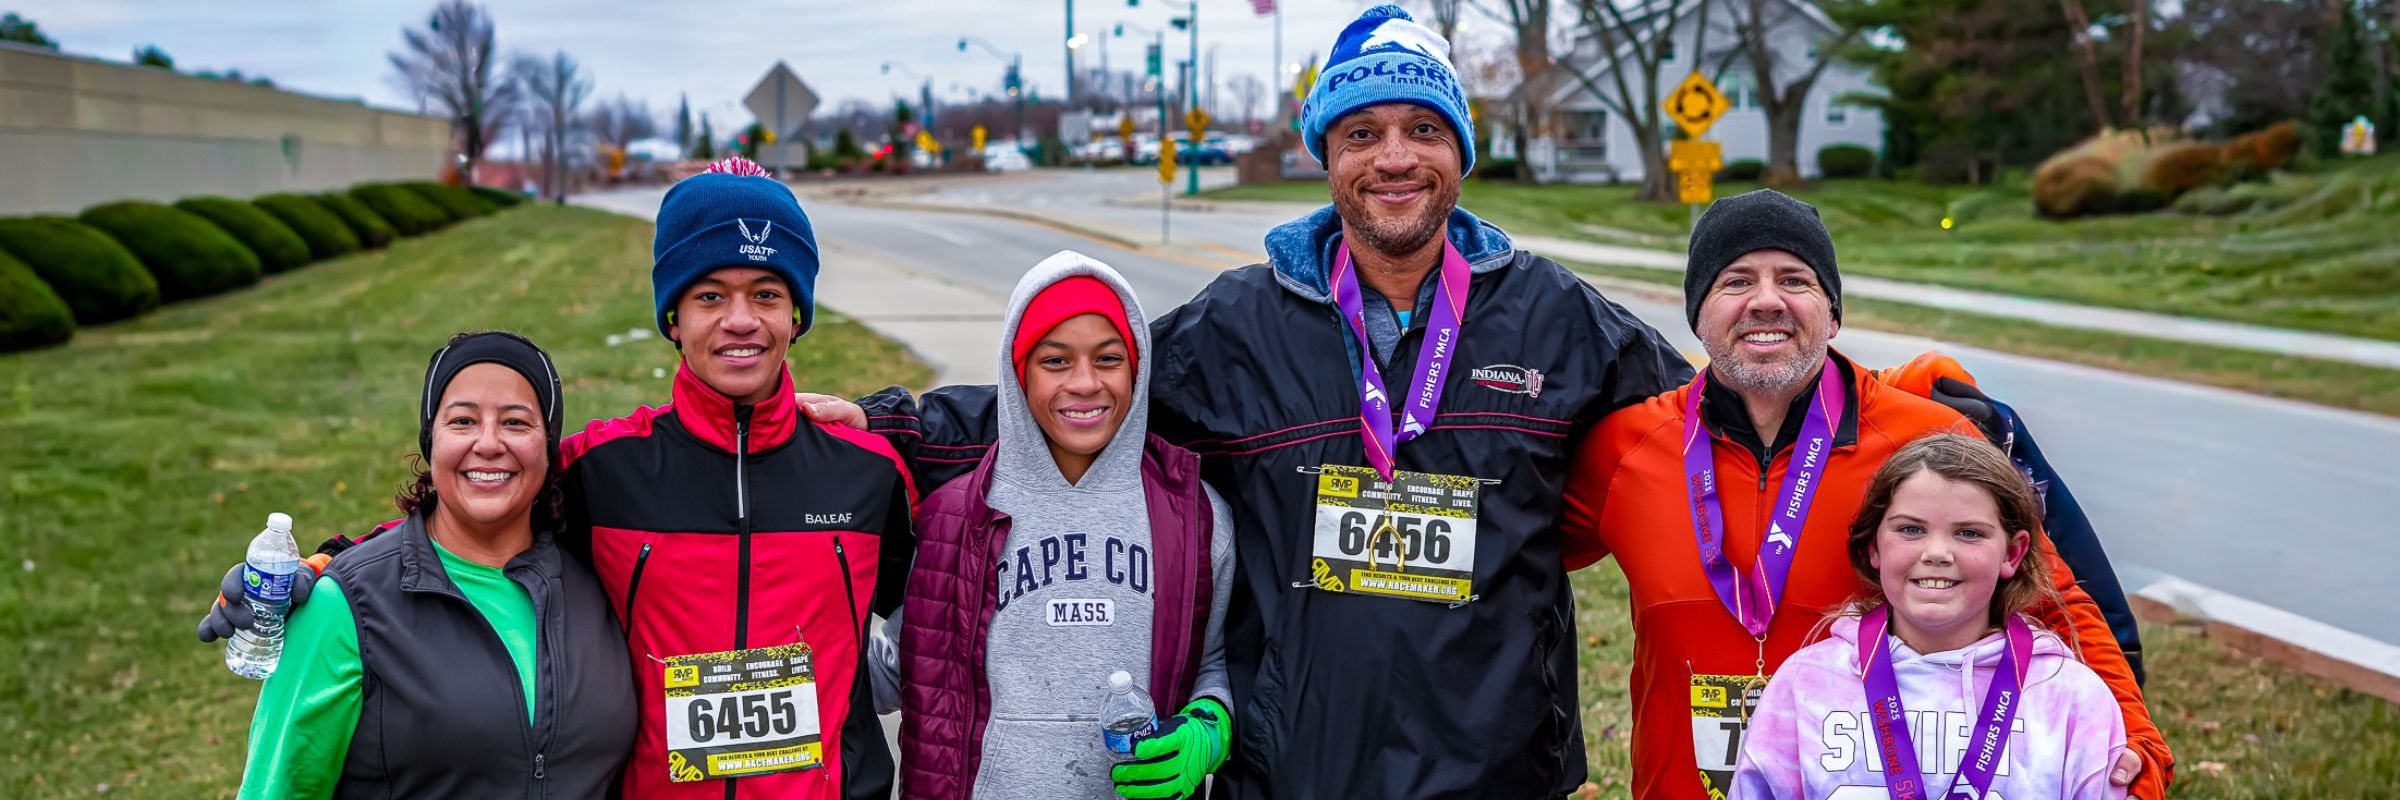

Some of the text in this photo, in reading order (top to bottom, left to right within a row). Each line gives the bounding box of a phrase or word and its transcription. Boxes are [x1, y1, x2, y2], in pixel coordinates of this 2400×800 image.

[1328, 60, 1449, 93] POLAR
[739, 244, 778, 256] USATF
[1419, 361, 1441, 409] FISHERS
[1432, 327, 1452, 365] YMCA
[1703, 468, 1712, 492] 2025
[1407, 485, 1445, 496] ENCOURAGE
[1452, 489, 1474, 498] SHAPE
[1775, 544, 1784, 555] the
[1786, 470, 1811, 519] FISHERS
[1803, 437, 1824, 469] YMCA
[1411, 495, 1439, 505] FITNESS.
[1452, 499, 1473, 508] LIVES.
[1690, 471, 1714, 545] WISHBONE
[805, 512, 853, 524] BALEAF
[1338, 511, 1452, 565] 6456
[996, 532, 1155, 613] CAPE CO
[1360, 578, 1458, 595] WWW.RACEMAKER.ORG
[1053, 603, 1109, 623] MASS.
[712, 664, 732, 674] BUILD
[745, 659, 784, 671] ENCOURAGE
[790, 655, 809, 665] SHAPE
[791, 664, 810, 674] LIVES.
[703, 673, 744, 684] COMMUNITY.
[751, 669, 780, 680] FITNESS.
[688, 690, 797, 743] 6455
[1887, 695, 1900, 721] 2025
[1873, 698, 1904, 776] WISHBONE
[1975, 726, 2000, 772] FISHERS
[1992, 690, 2012, 725] YMCA
[718, 752, 811, 771] WWW.RACEMAKER.ORG
